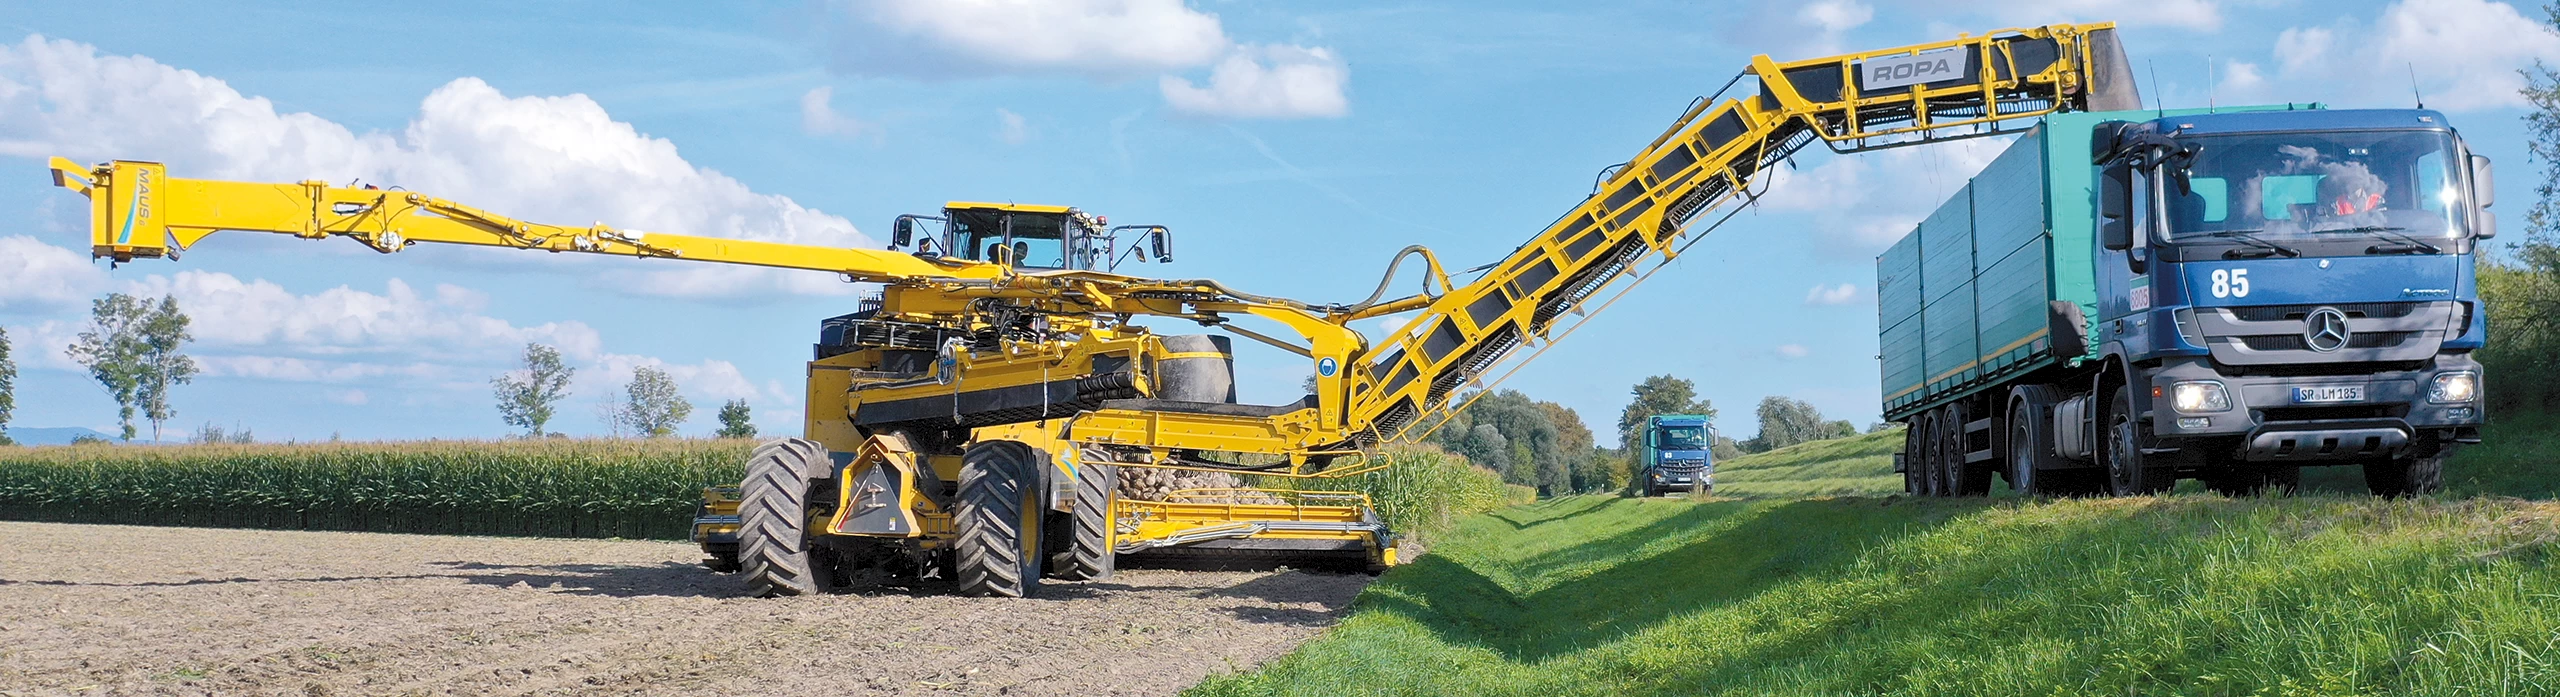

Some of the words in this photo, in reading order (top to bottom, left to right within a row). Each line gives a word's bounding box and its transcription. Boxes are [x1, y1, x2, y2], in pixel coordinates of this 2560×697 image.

[1873, 59, 1951, 82] ROPA
[139, 167, 149, 219] MAUS
[2211, 268, 2249, 298] 85
[2301, 389, 2314, 400] SR
[2321, 388, 2335, 399] LM
[2337, 387, 2356, 399] 185
